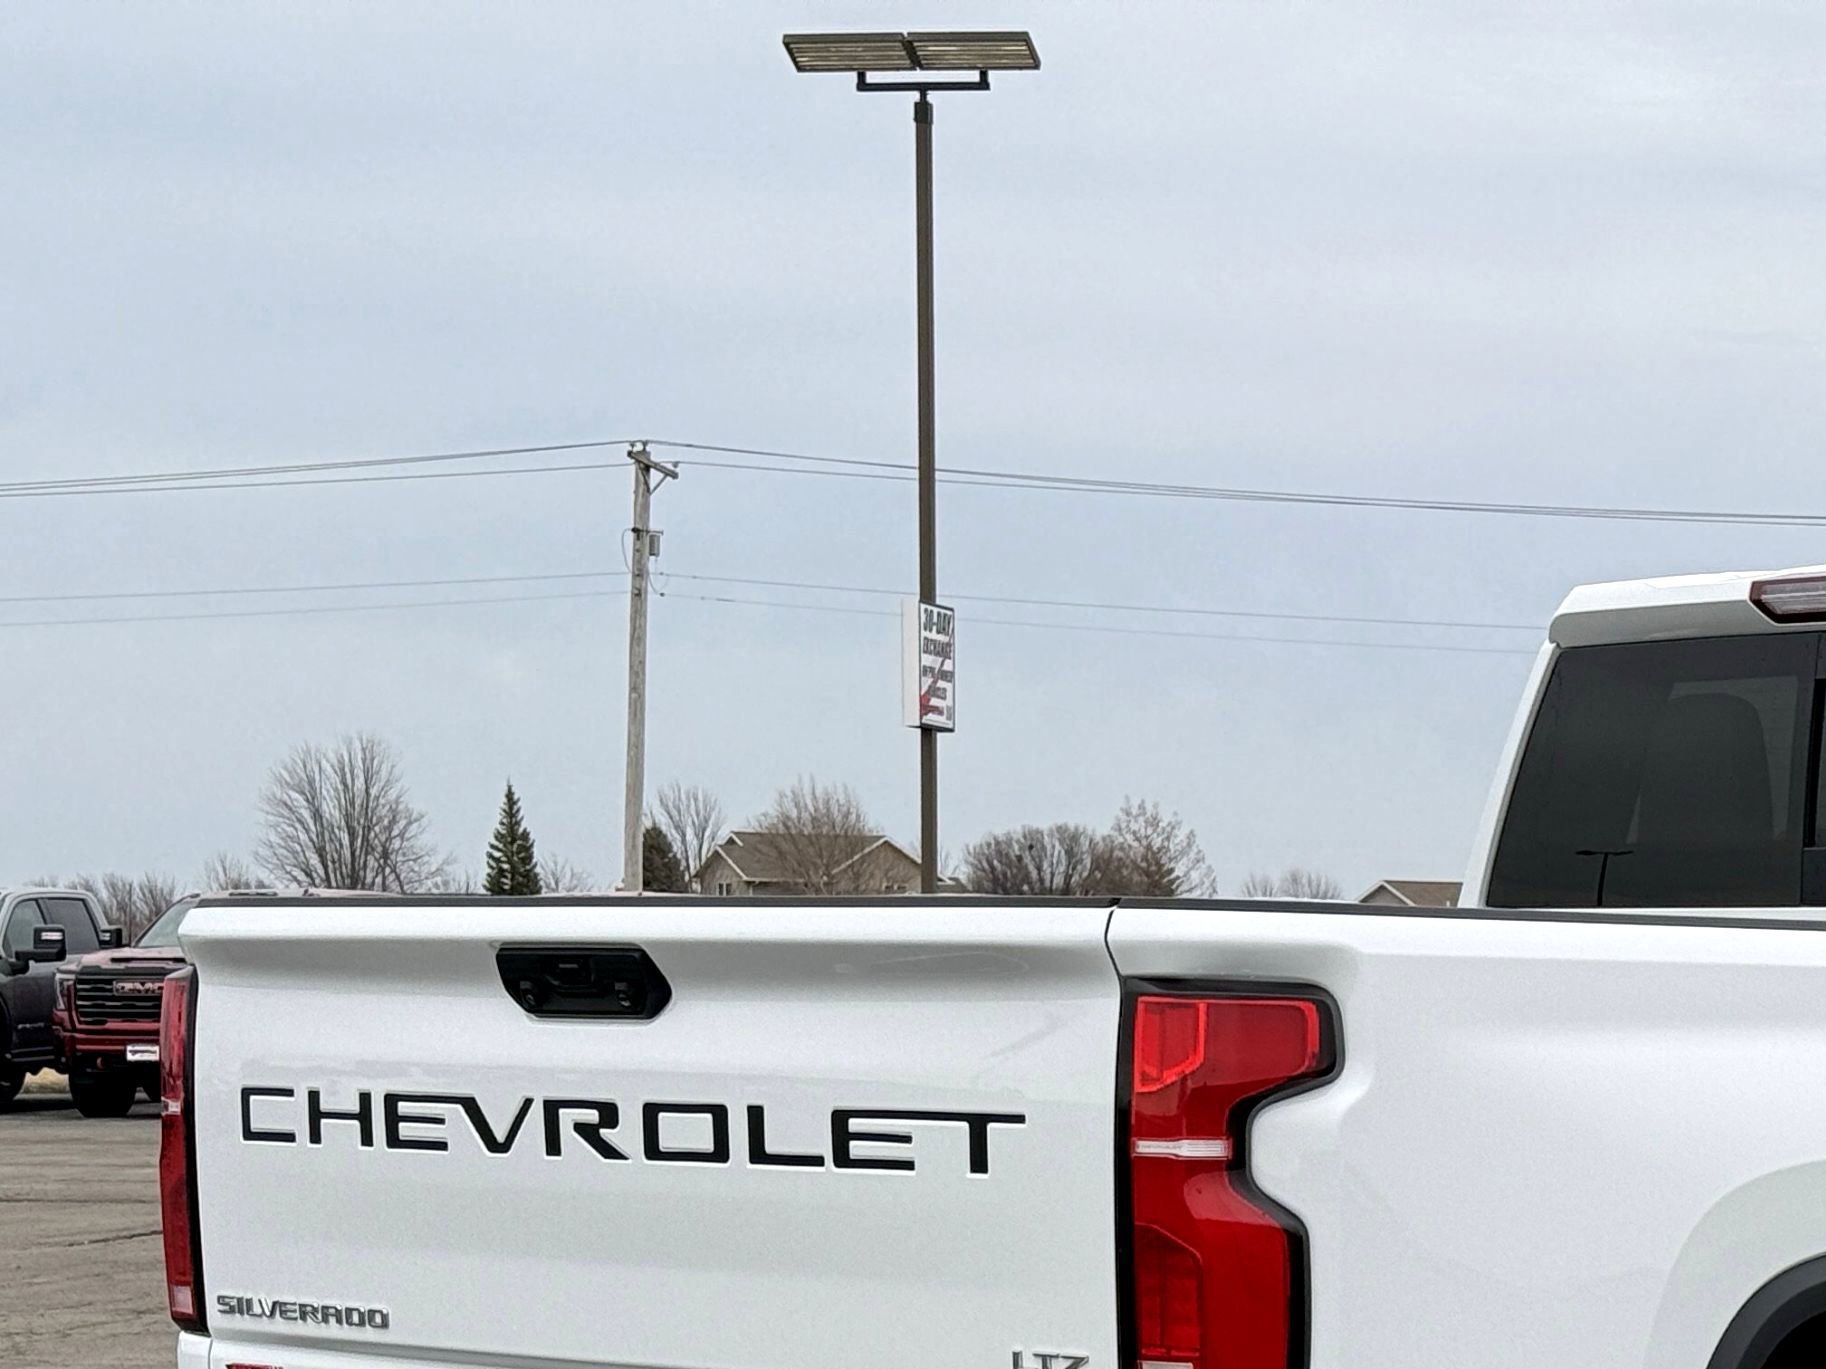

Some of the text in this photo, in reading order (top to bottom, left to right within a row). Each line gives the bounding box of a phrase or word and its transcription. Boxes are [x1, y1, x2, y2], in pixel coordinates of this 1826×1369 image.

[923, 608, 952, 637] 30-DAY
[241, 1085, 1026, 1174] CHEVROLET
[217, 1295, 390, 1330] SILVERADO
